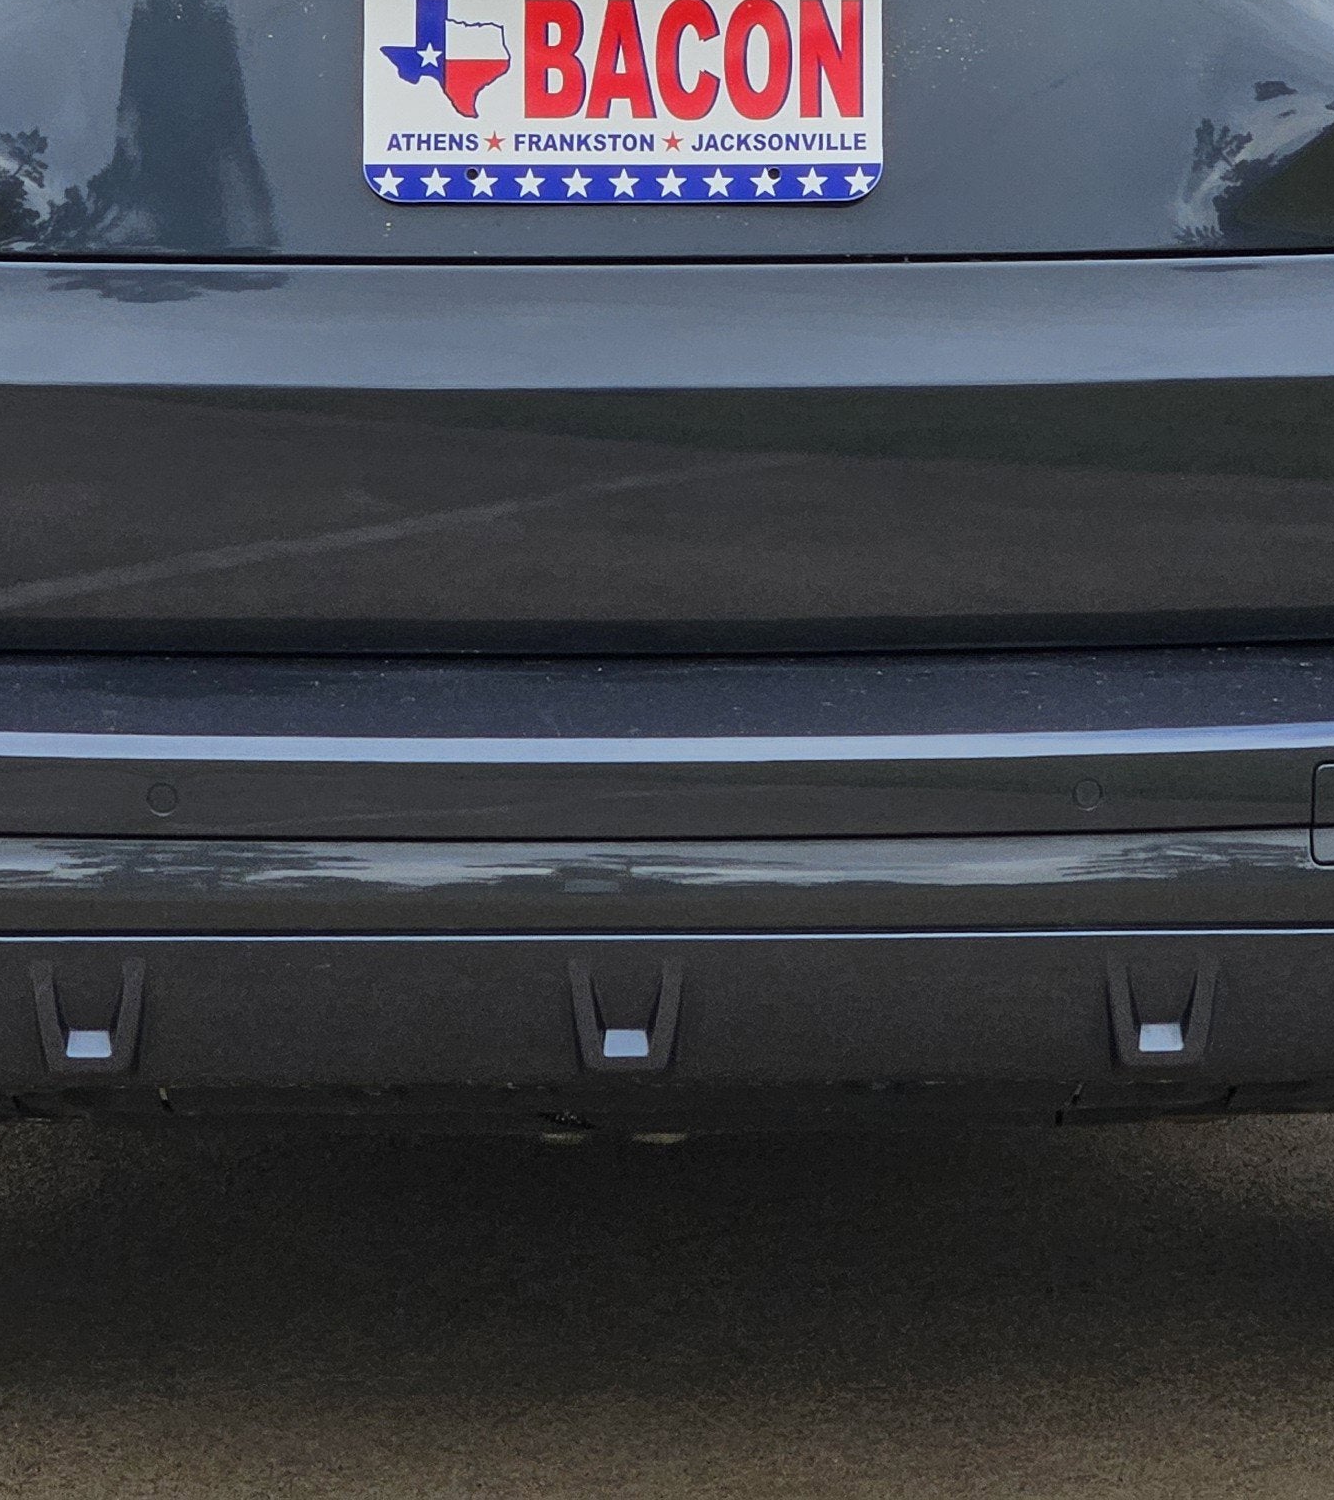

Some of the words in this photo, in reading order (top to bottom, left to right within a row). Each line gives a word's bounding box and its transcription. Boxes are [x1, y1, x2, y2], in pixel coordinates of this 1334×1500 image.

[387, 133, 480, 151] ATHENS
[513, 133, 655, 151] FRANKSTON
[691, 132, 867, 151] JACKSONVILLE
